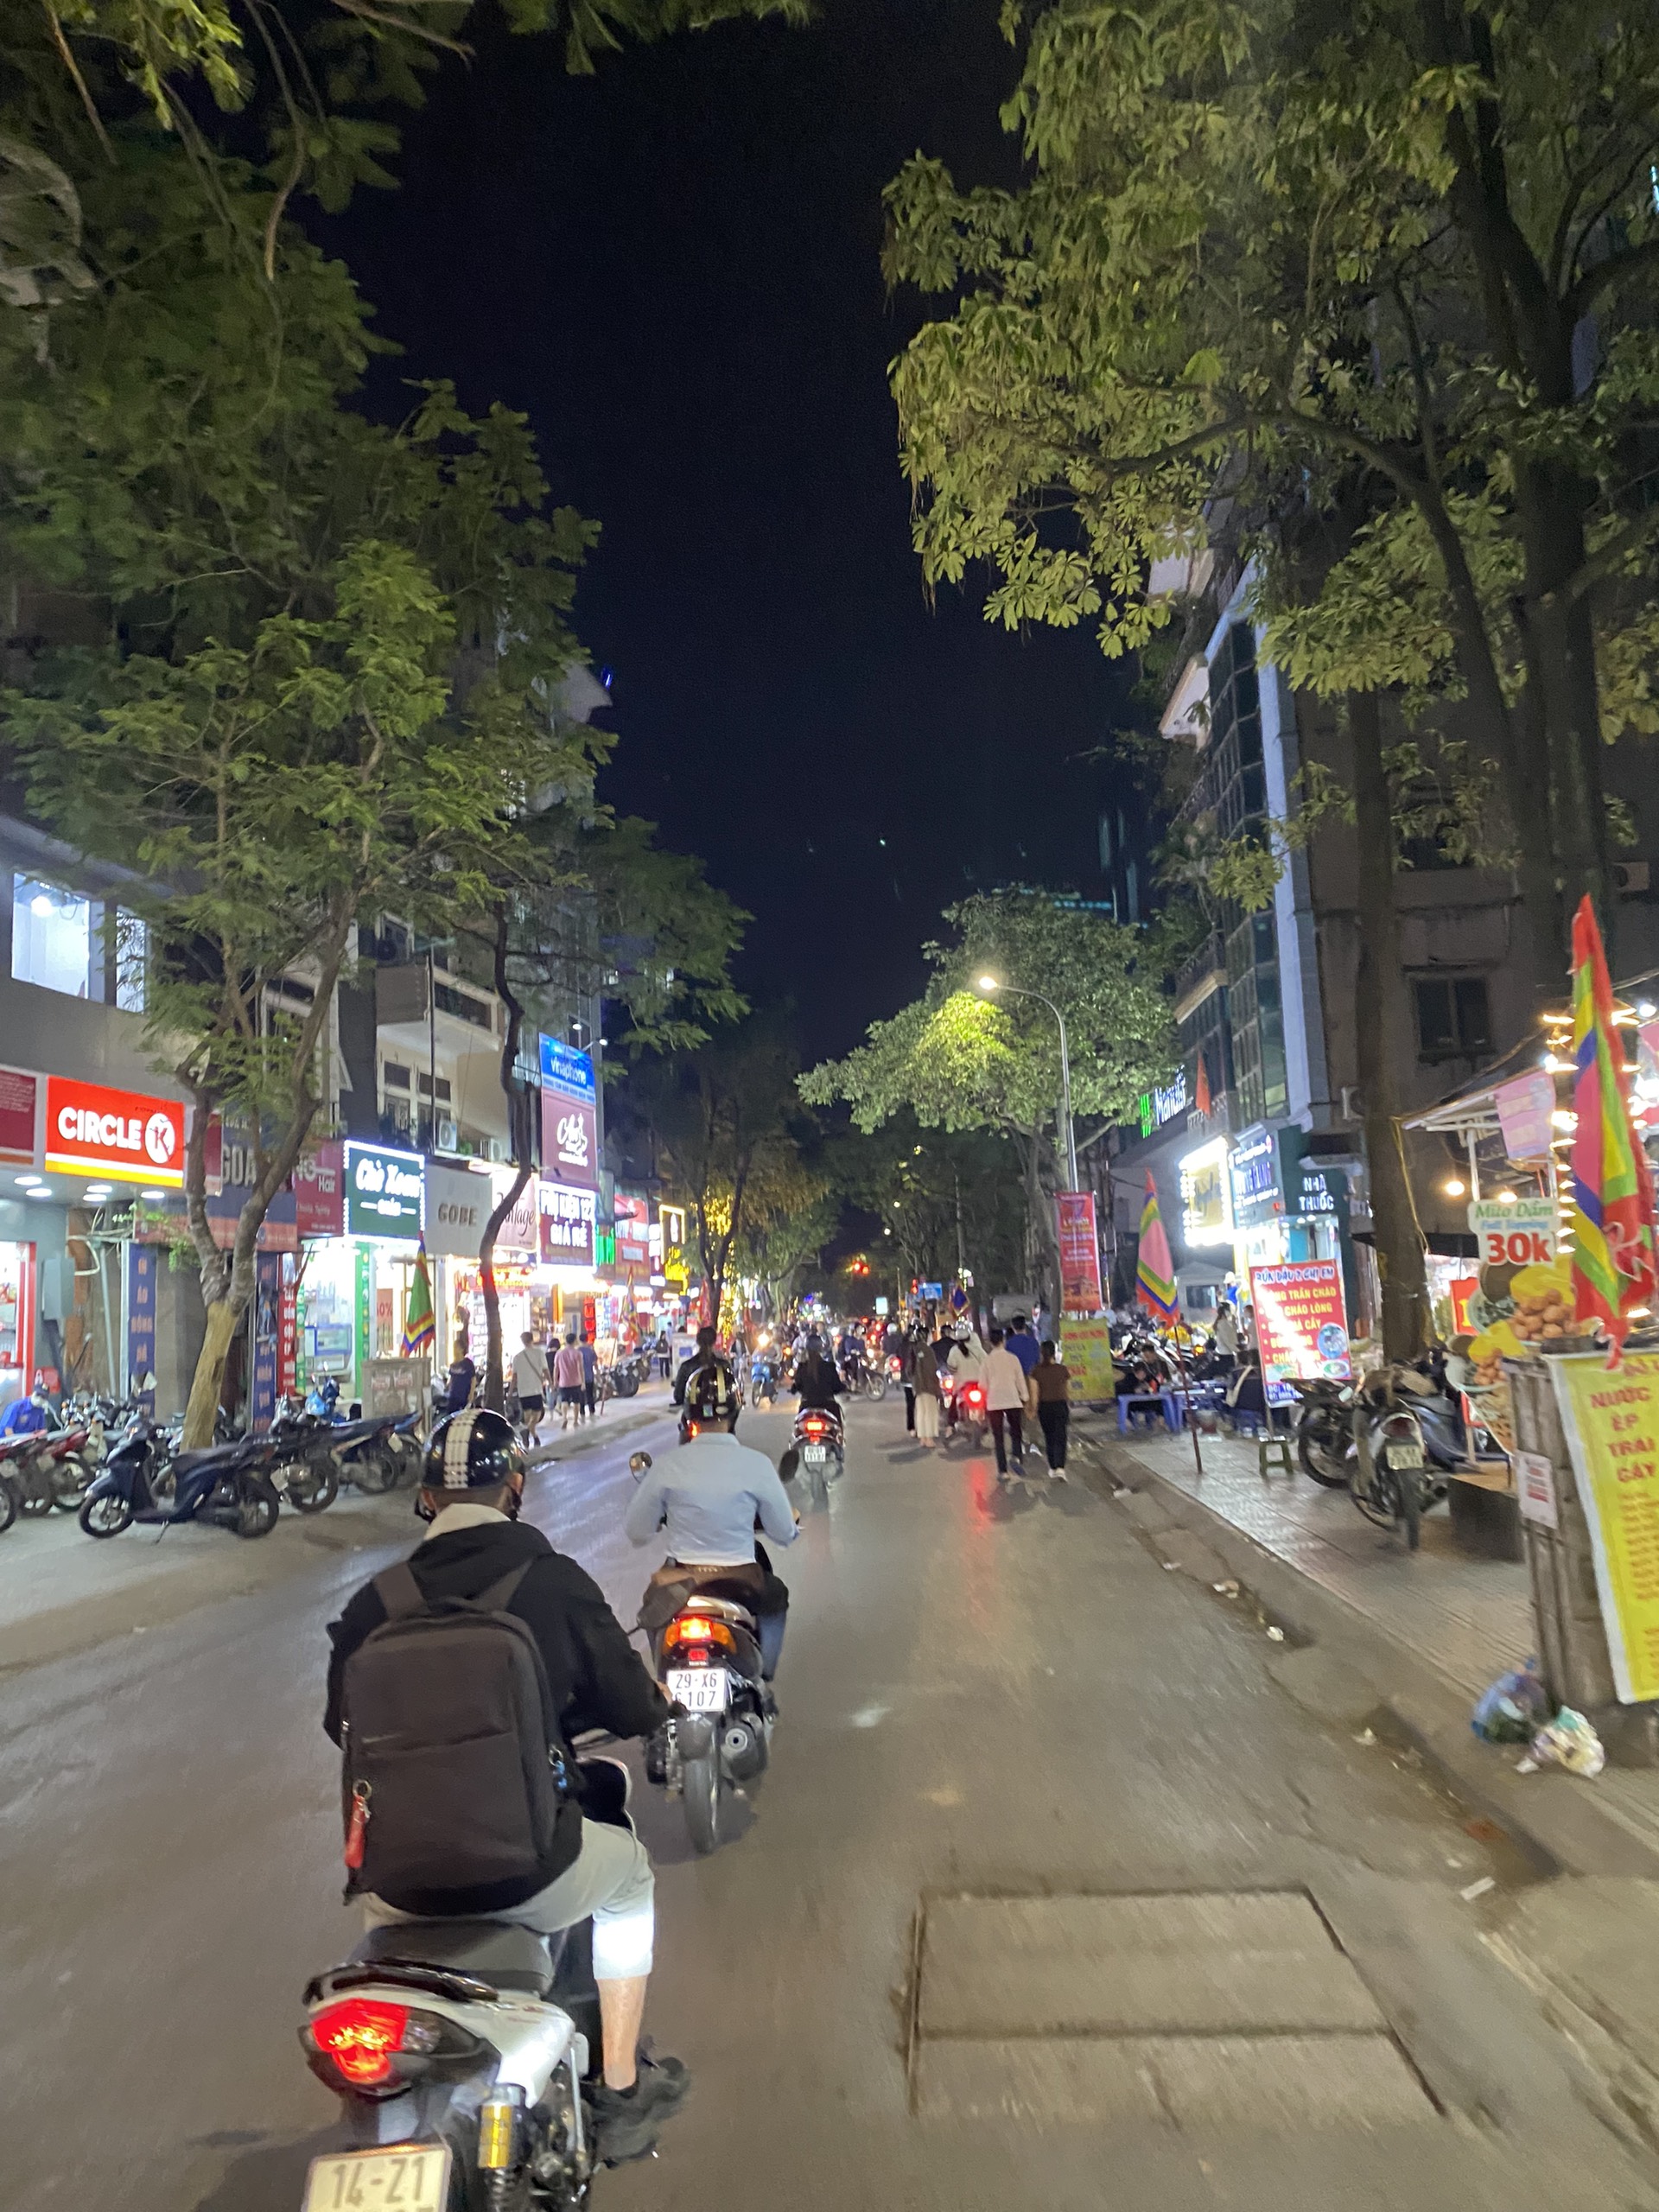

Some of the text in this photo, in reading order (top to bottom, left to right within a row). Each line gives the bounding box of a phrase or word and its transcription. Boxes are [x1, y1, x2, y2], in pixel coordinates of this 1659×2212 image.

[550, 1056, 586, 1084] vinaphone
[58, 1106, 174, 1161] CIRCLE K
[318, 1175, 335, 1193] Hair
[1303, 1173, 1326, 1192] NHÀ
[1299, 1191, 1334, 1211] THUỐC
[1486, 1232, 1553, 1263] 30k
[1311, 1302, 1332, 1314] LÒNG
[332, 2156, 425, 2209] 14-Z1
